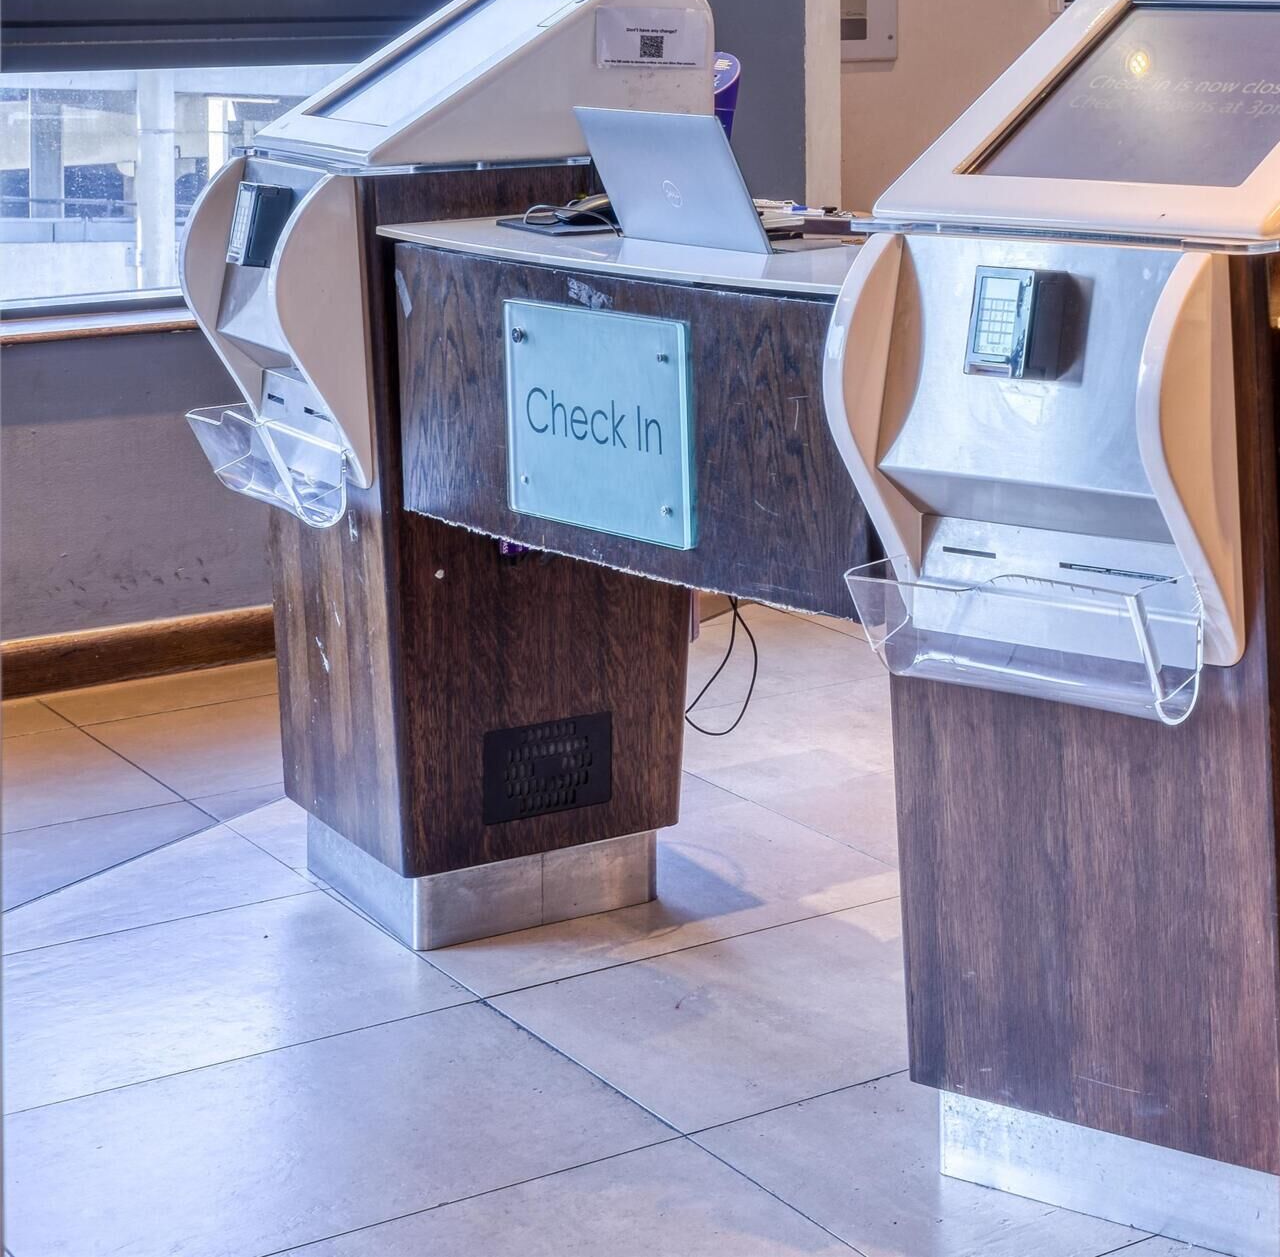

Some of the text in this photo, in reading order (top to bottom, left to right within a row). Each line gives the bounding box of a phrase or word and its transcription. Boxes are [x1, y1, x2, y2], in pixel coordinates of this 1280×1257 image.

[1194, 80, 1240, 94] now
[526, 385, 664, 456] Check In
